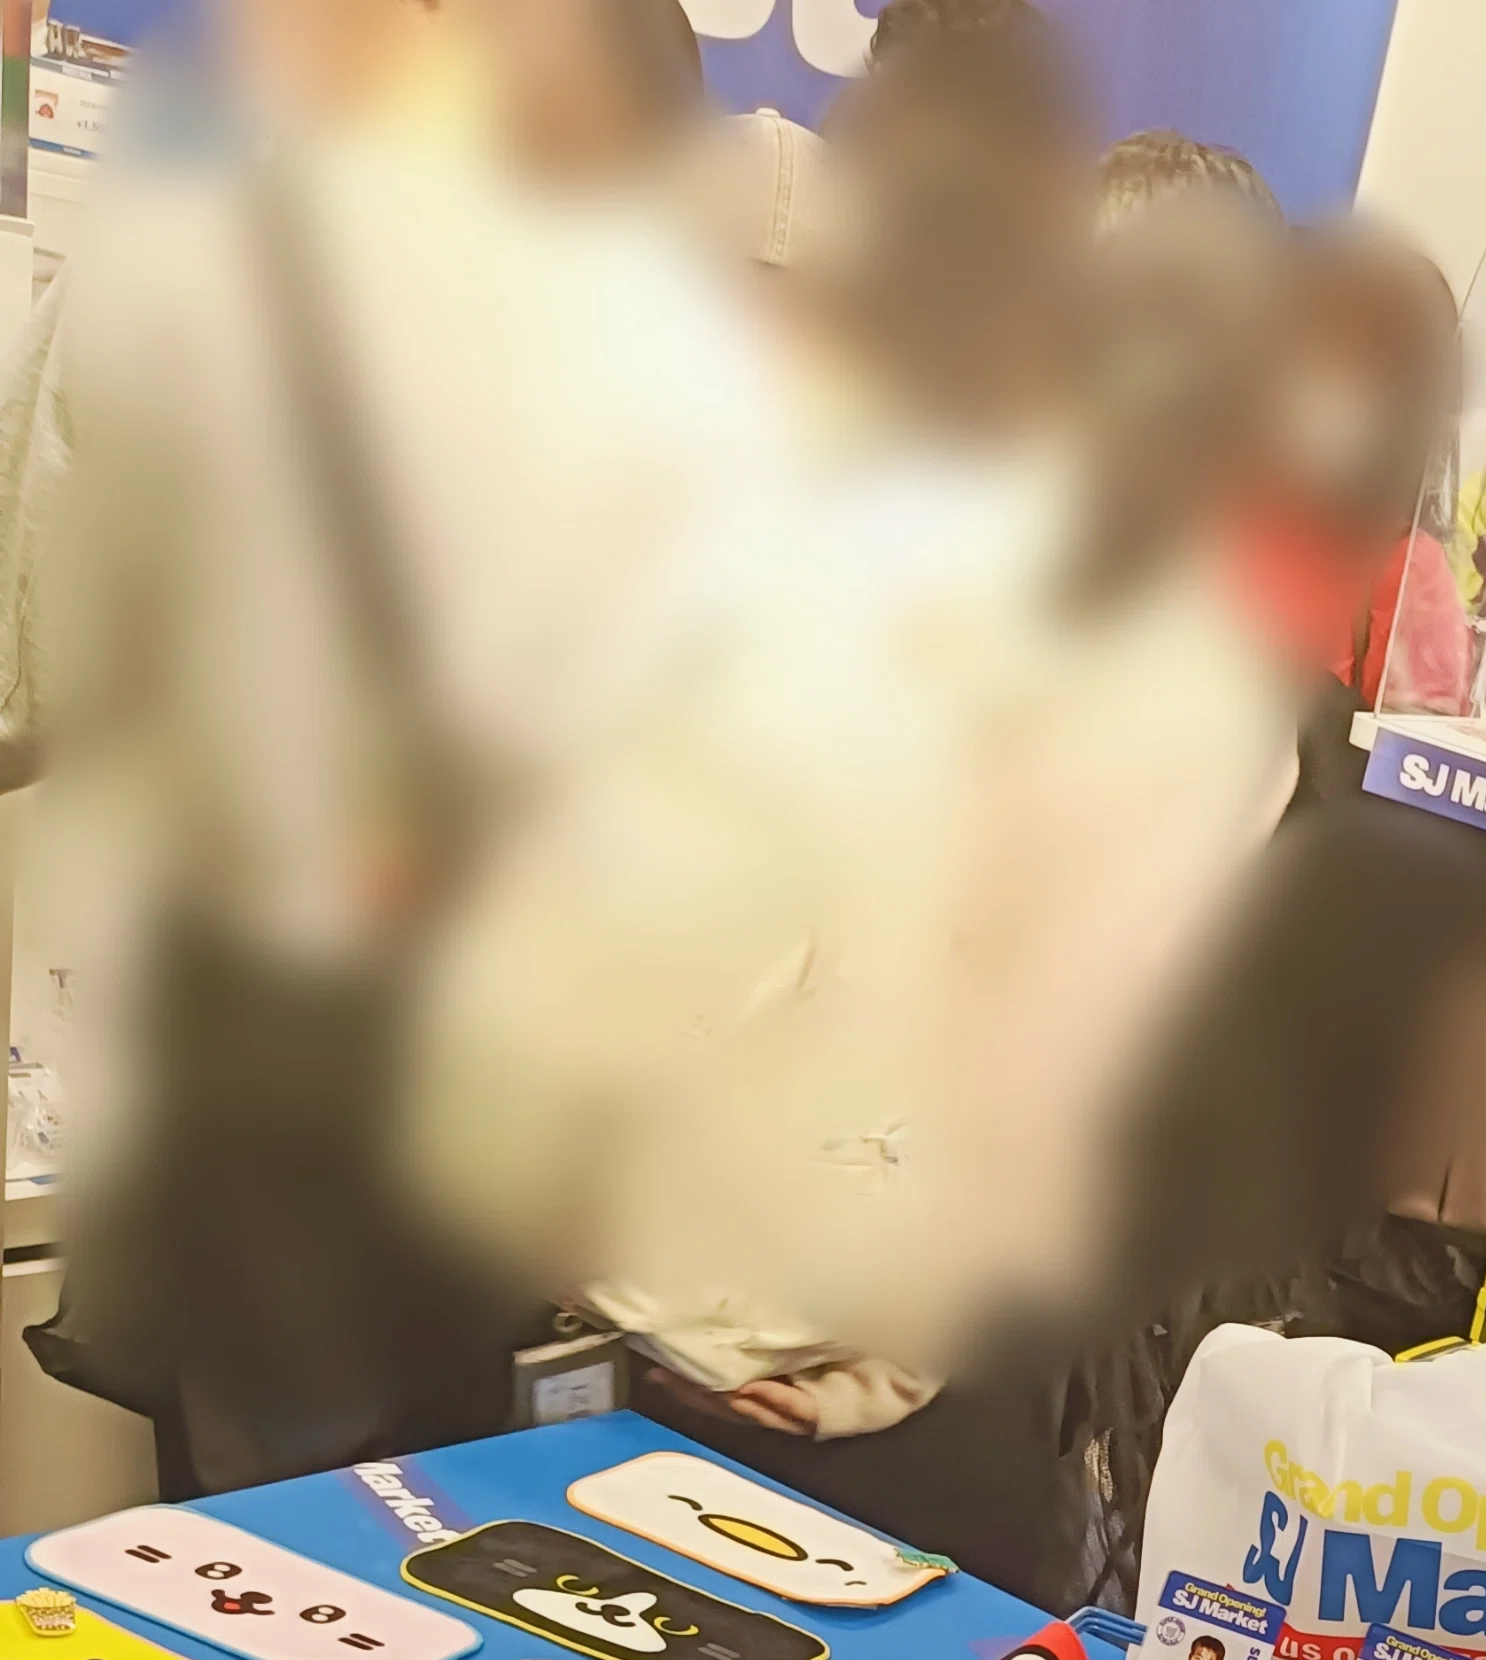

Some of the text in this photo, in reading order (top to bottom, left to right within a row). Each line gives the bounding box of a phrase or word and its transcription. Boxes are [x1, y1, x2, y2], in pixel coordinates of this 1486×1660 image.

[1399, 753, 1445, 795] SJ
[1263, 1439, 1412, 1527] Grand
[1242, 1490, 1308, 1607] SJ
[1172, 1588, 1199, 1610] SJ
[1197, 1599, 1270, 1636] Market
[1184, 1581, 1268, 1619] Grand Opening!
[1385, 1635, 1421, 1658] Grand
